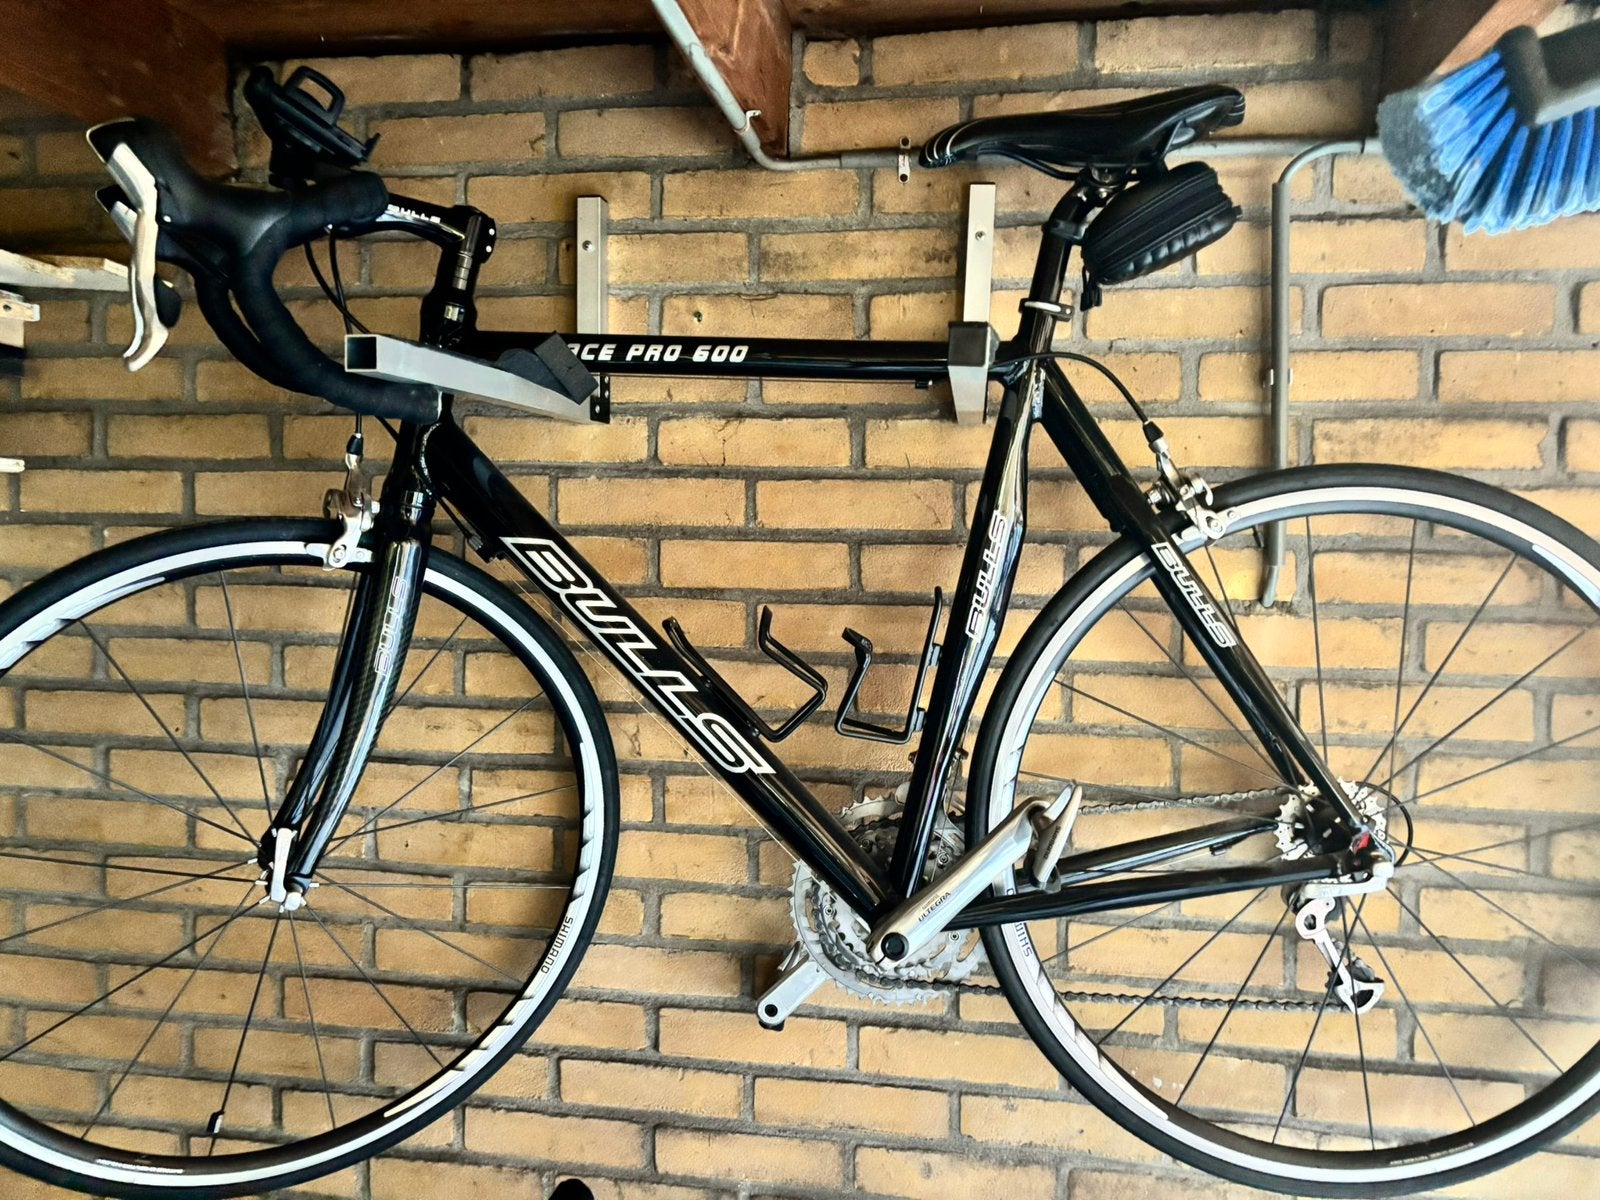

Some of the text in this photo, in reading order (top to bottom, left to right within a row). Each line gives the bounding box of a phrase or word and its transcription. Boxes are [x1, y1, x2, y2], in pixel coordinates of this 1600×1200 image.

[625, 344, 682, 362] PRO
[692, 345, 749, 363] 600
[374, 575, 407, 676] BULLS
[965, 509, 1007, 643] BULLS
[1151, 541, 1237, 648] BULLS
[499, 536, 777, 774] BULLS
[540, 915, 574, 974] SHIMANO
[918, 891, 951, 922] ULTEGRA
